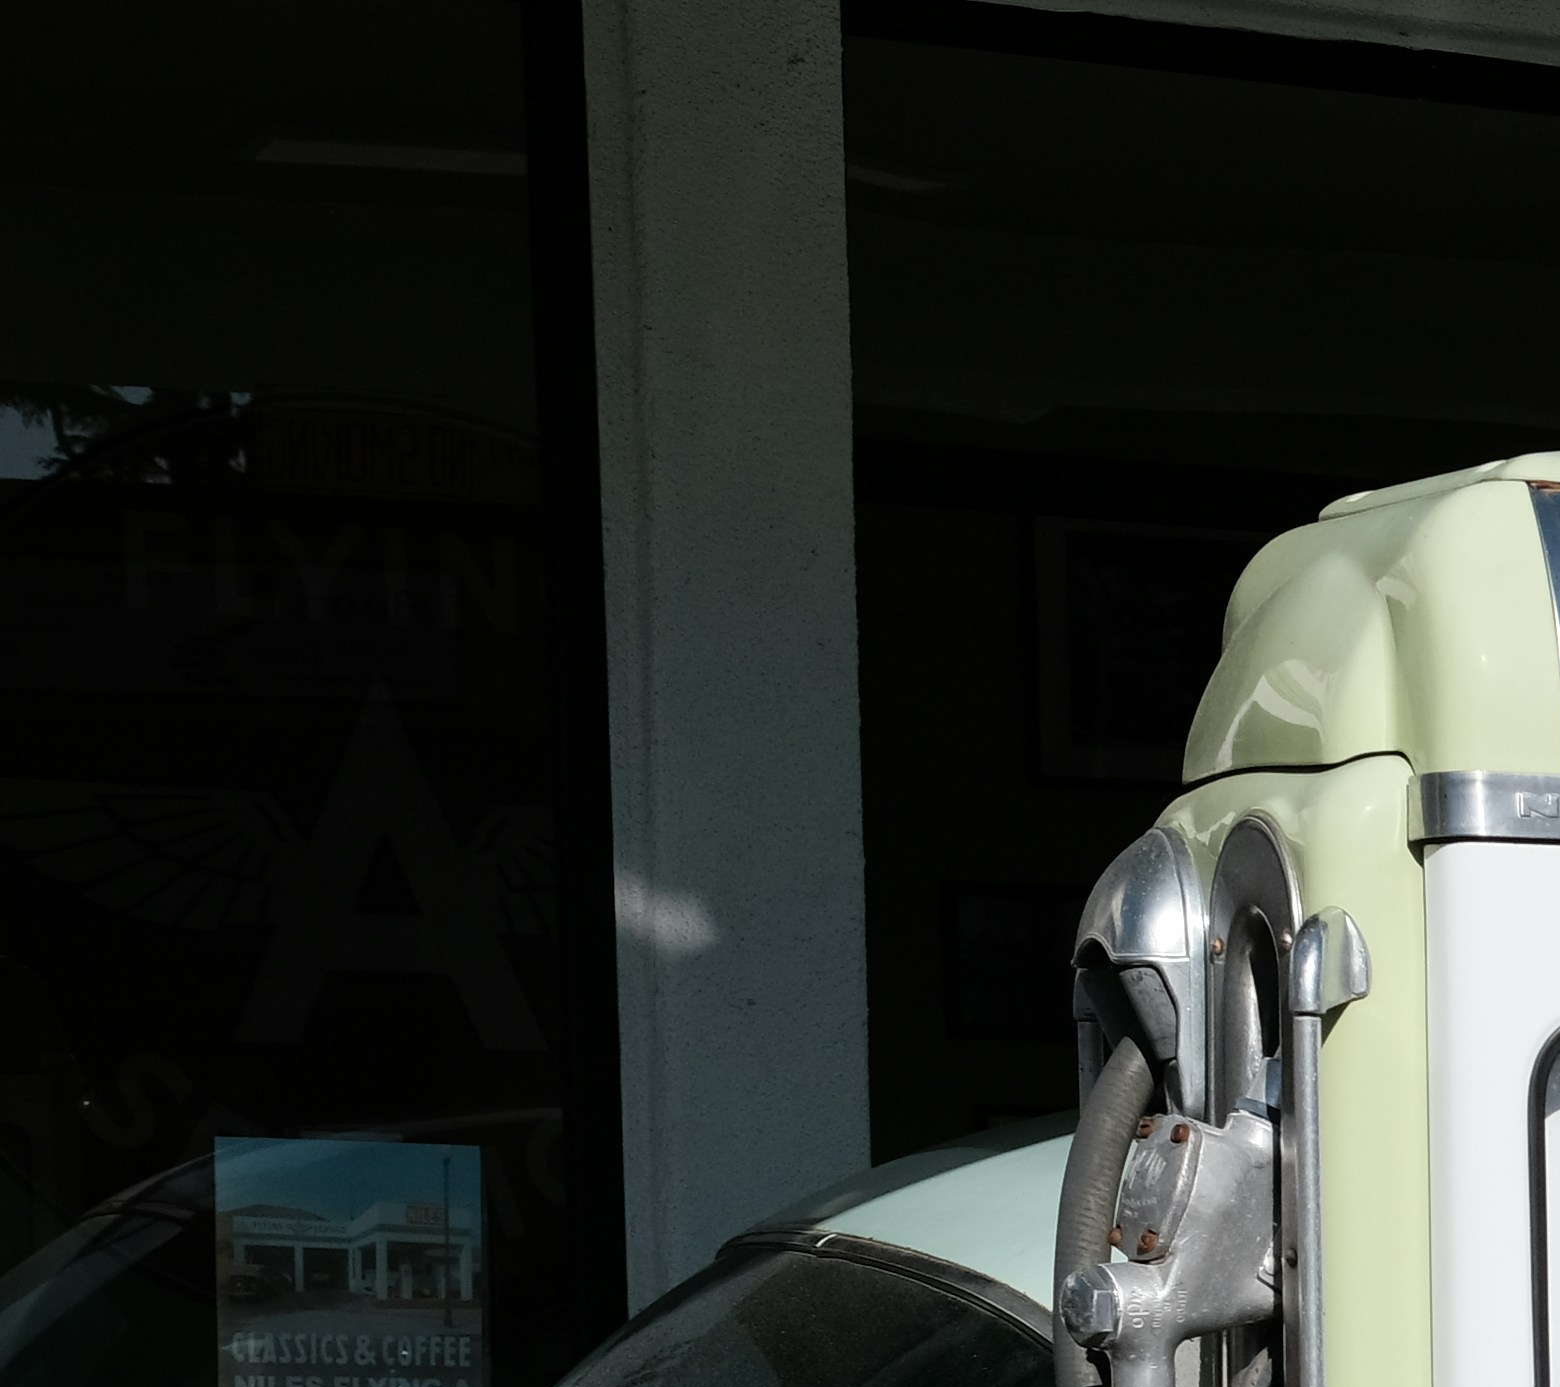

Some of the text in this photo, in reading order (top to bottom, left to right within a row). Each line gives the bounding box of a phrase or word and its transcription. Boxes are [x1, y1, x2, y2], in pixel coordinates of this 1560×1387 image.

[232, 1333, 471, 1367] CLASSICS & COFFEE
